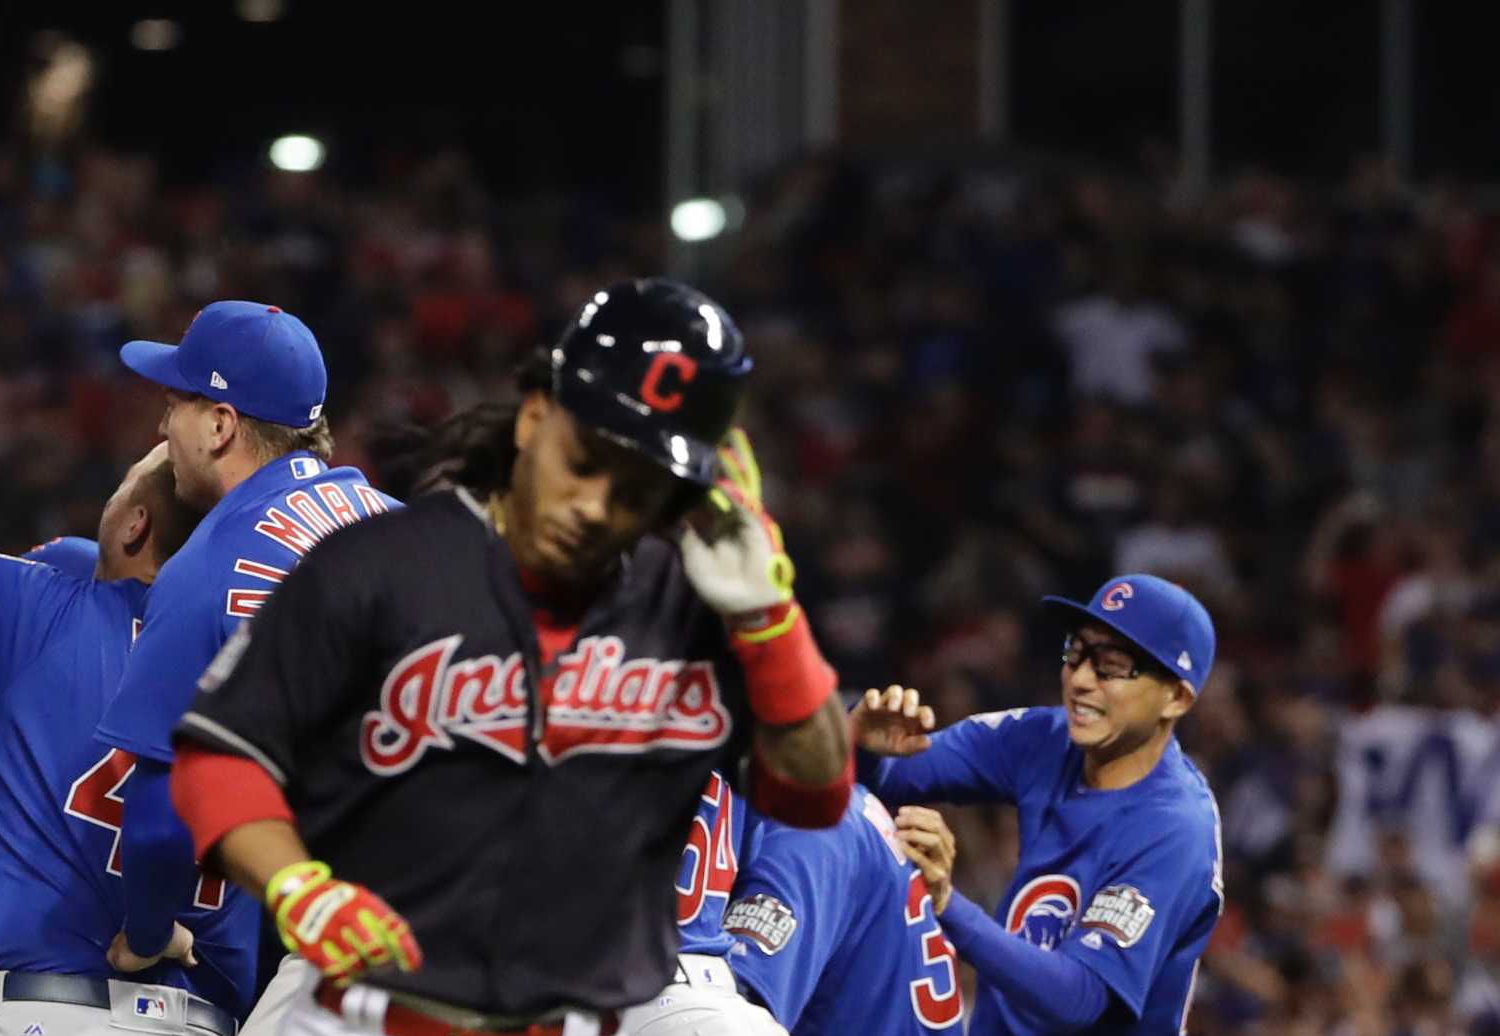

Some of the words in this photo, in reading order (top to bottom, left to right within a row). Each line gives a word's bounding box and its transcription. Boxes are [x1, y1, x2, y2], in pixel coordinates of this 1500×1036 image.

[640, 352, 697, 412] C
[1101, 582, 1133, 611] C
[361, 634, 730, 775] Indians
[731, 903, 791, 932] WORLD
[1081, 907, 1140, 936] SERIES
[1092, 893, 1147, 921] WORLD
[722, 915, 785, 946] SERIES
